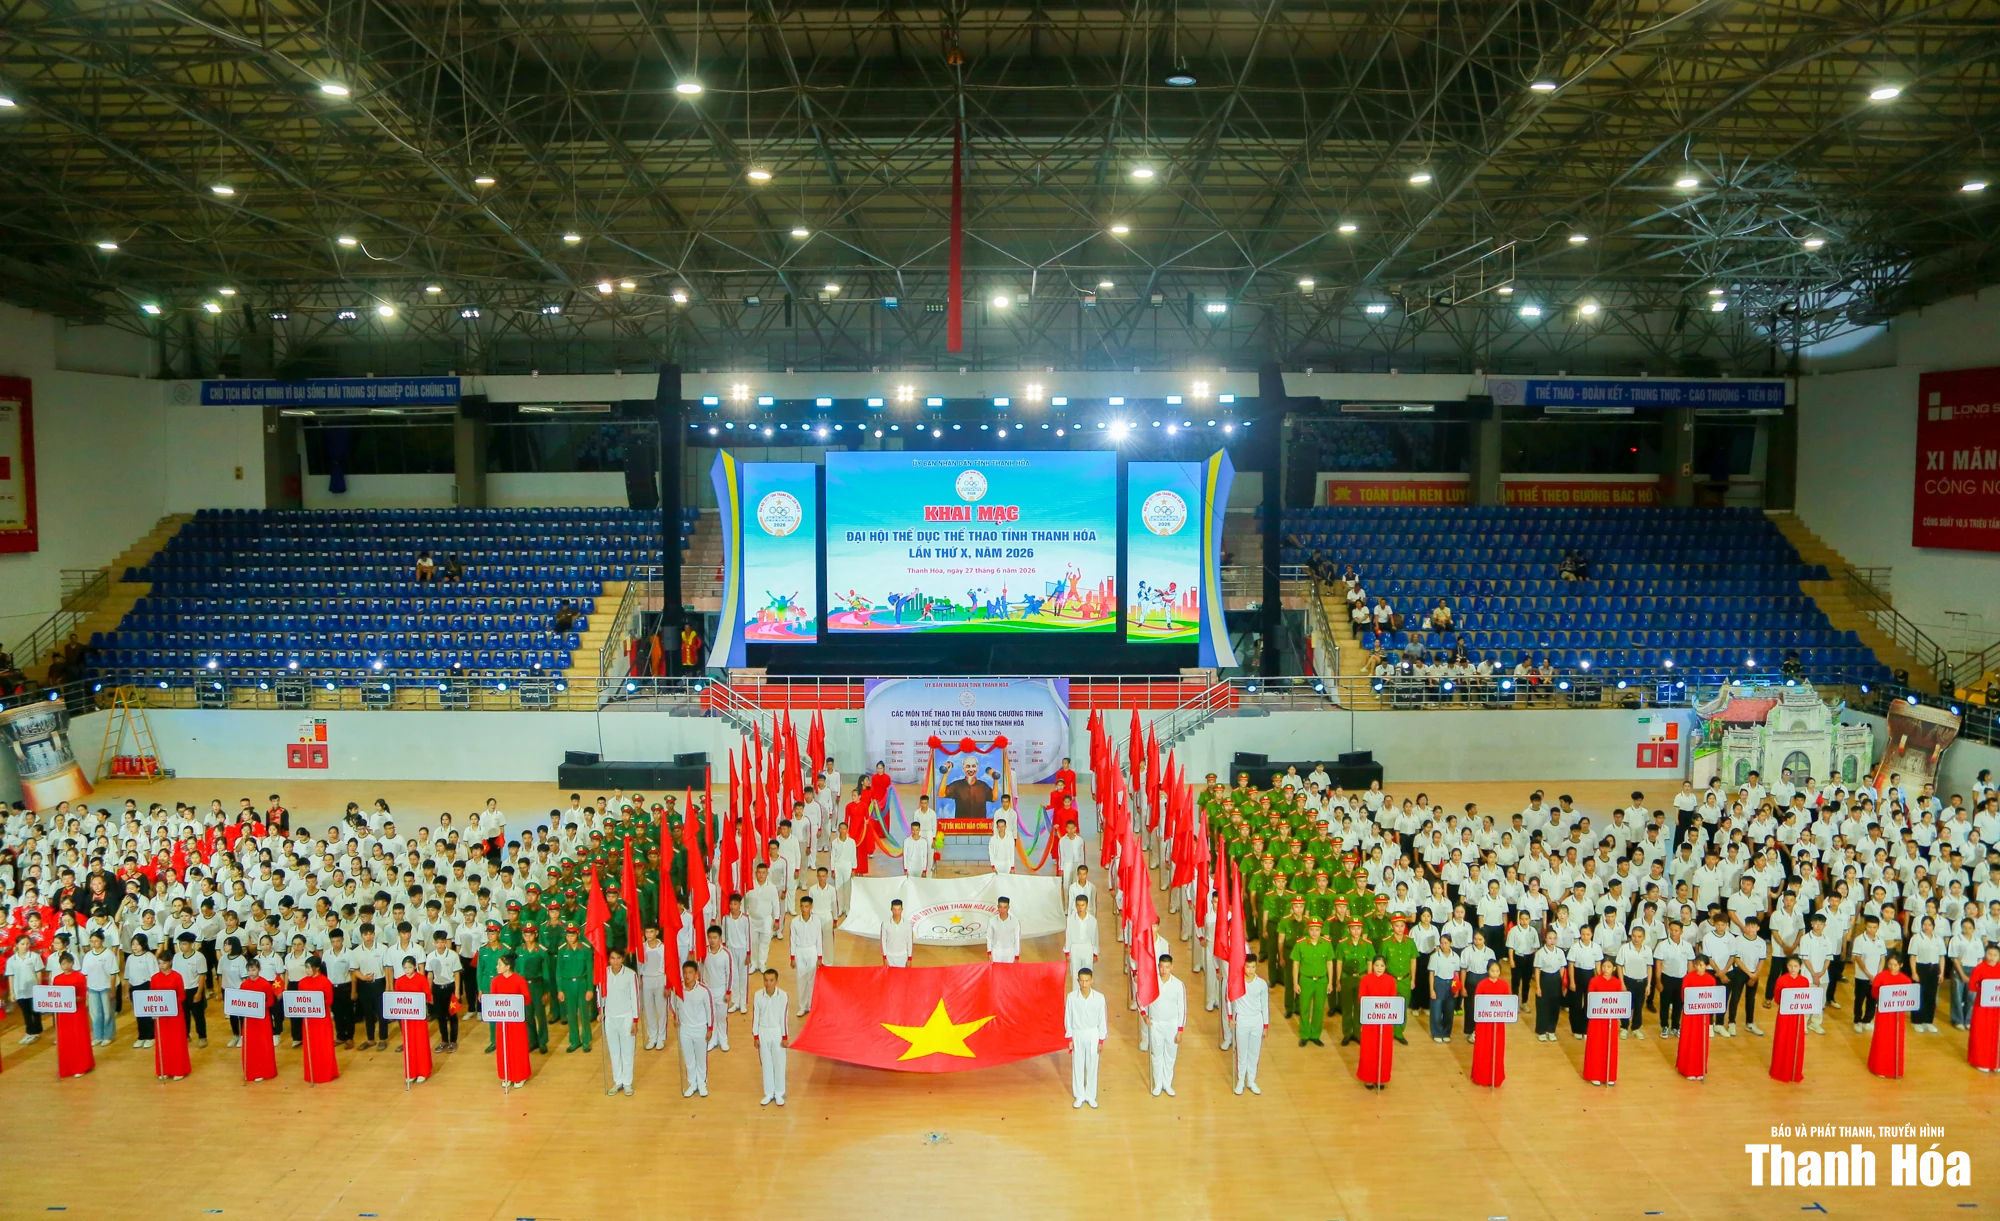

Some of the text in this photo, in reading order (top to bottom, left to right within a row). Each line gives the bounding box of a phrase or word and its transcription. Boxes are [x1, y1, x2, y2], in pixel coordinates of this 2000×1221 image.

[1954, 404, 1990, 415] LONG
[1926, 446, 2000, 470] XI MĂN
[1925, 477, 1977, 495] CÔNG
[1446, 488, 1468, 502] LUY
[924, 506, 1019, 525] KHAI MẠC
[847, 527, 1096, 543] ĐẠI HỘI THỂ DỤC THỂ THAO TỈNH THANH HÓA
[935, 546, 958, 558] THỨ
[975, 546, 1002, 558] NĂM
[1006, 548, 1034, 558] 2026
[930, 567, 945, 575] Hóa,
[947, 567, 963, 575] ngày
[975, 567, 995, 575] tháng
[922, 708, 933, 717] THỂ
[963, 708, 975, 717] ĐẤU
[1025, 709, 1044, 717] TRÌNH
[48, 990, 61, 998] MÔN
[231, 999, 246, 1007] MÔN
[397, 996, 412, 1004] MÔN
[495, 998, 511, 1007] KHỐI
[144, 1005, 157, 1013] VIỆT
[1375, 1001, 1391, 1009] KHỐI
[1688, 1002, 1722, 1010] TAEKWONDO
[1884, 1001, 1895, 1009] VẬT
[508, 1010, 519, 1018] ĐỘI
[1368, 1012, 1386, 1020] CÔNG
